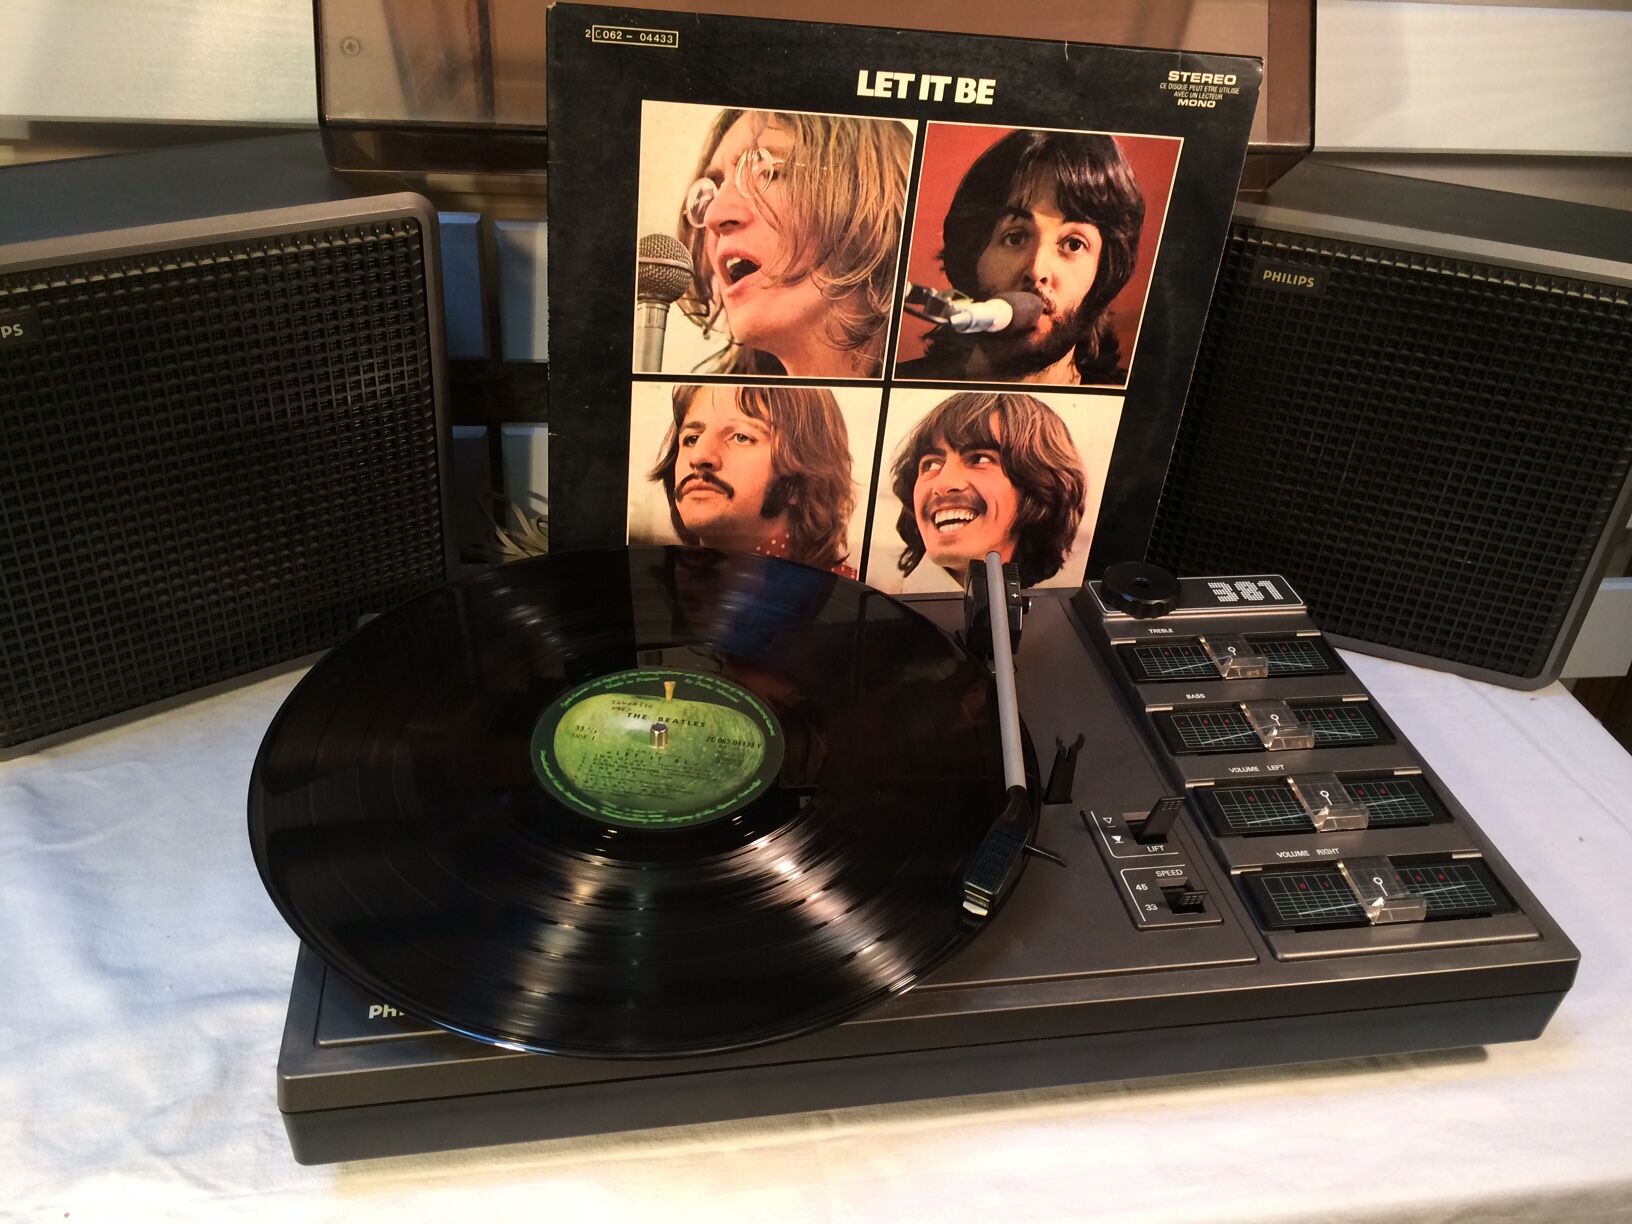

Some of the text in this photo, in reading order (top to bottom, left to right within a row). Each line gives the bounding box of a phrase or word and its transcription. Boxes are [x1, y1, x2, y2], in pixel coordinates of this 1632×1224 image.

[639, 32, 674, 44] 04433
[1167, 70, 1237, 86] STEREO
[856, 69, 997, 105] LET IT BE
[1160, 82, 1168, 90] CE
[1168, 83, 1188, 91] DISQUE
[1189, 84, 1203, 92] PEUT
[1173, 90, 1189, 98] AVEC
[1198, 92, 1224, 100] LECTEUR
[1177, 98, 1217, 108] MONO
[1263, 269, 1315, 288] PHILIPS
[1207, 580, 1284, 603] 381
[627, 712, 706, 728] THE BEATLES
[1228, 765, 1261, 773] VOLUME
[1146, 845, 1165, 853] LIFT
[1276, 847, 1340, 858] VOLUME RIGHT
[1155, 868, 1184, 878] SPEED
[1135, 883, 1149, 891] 45
